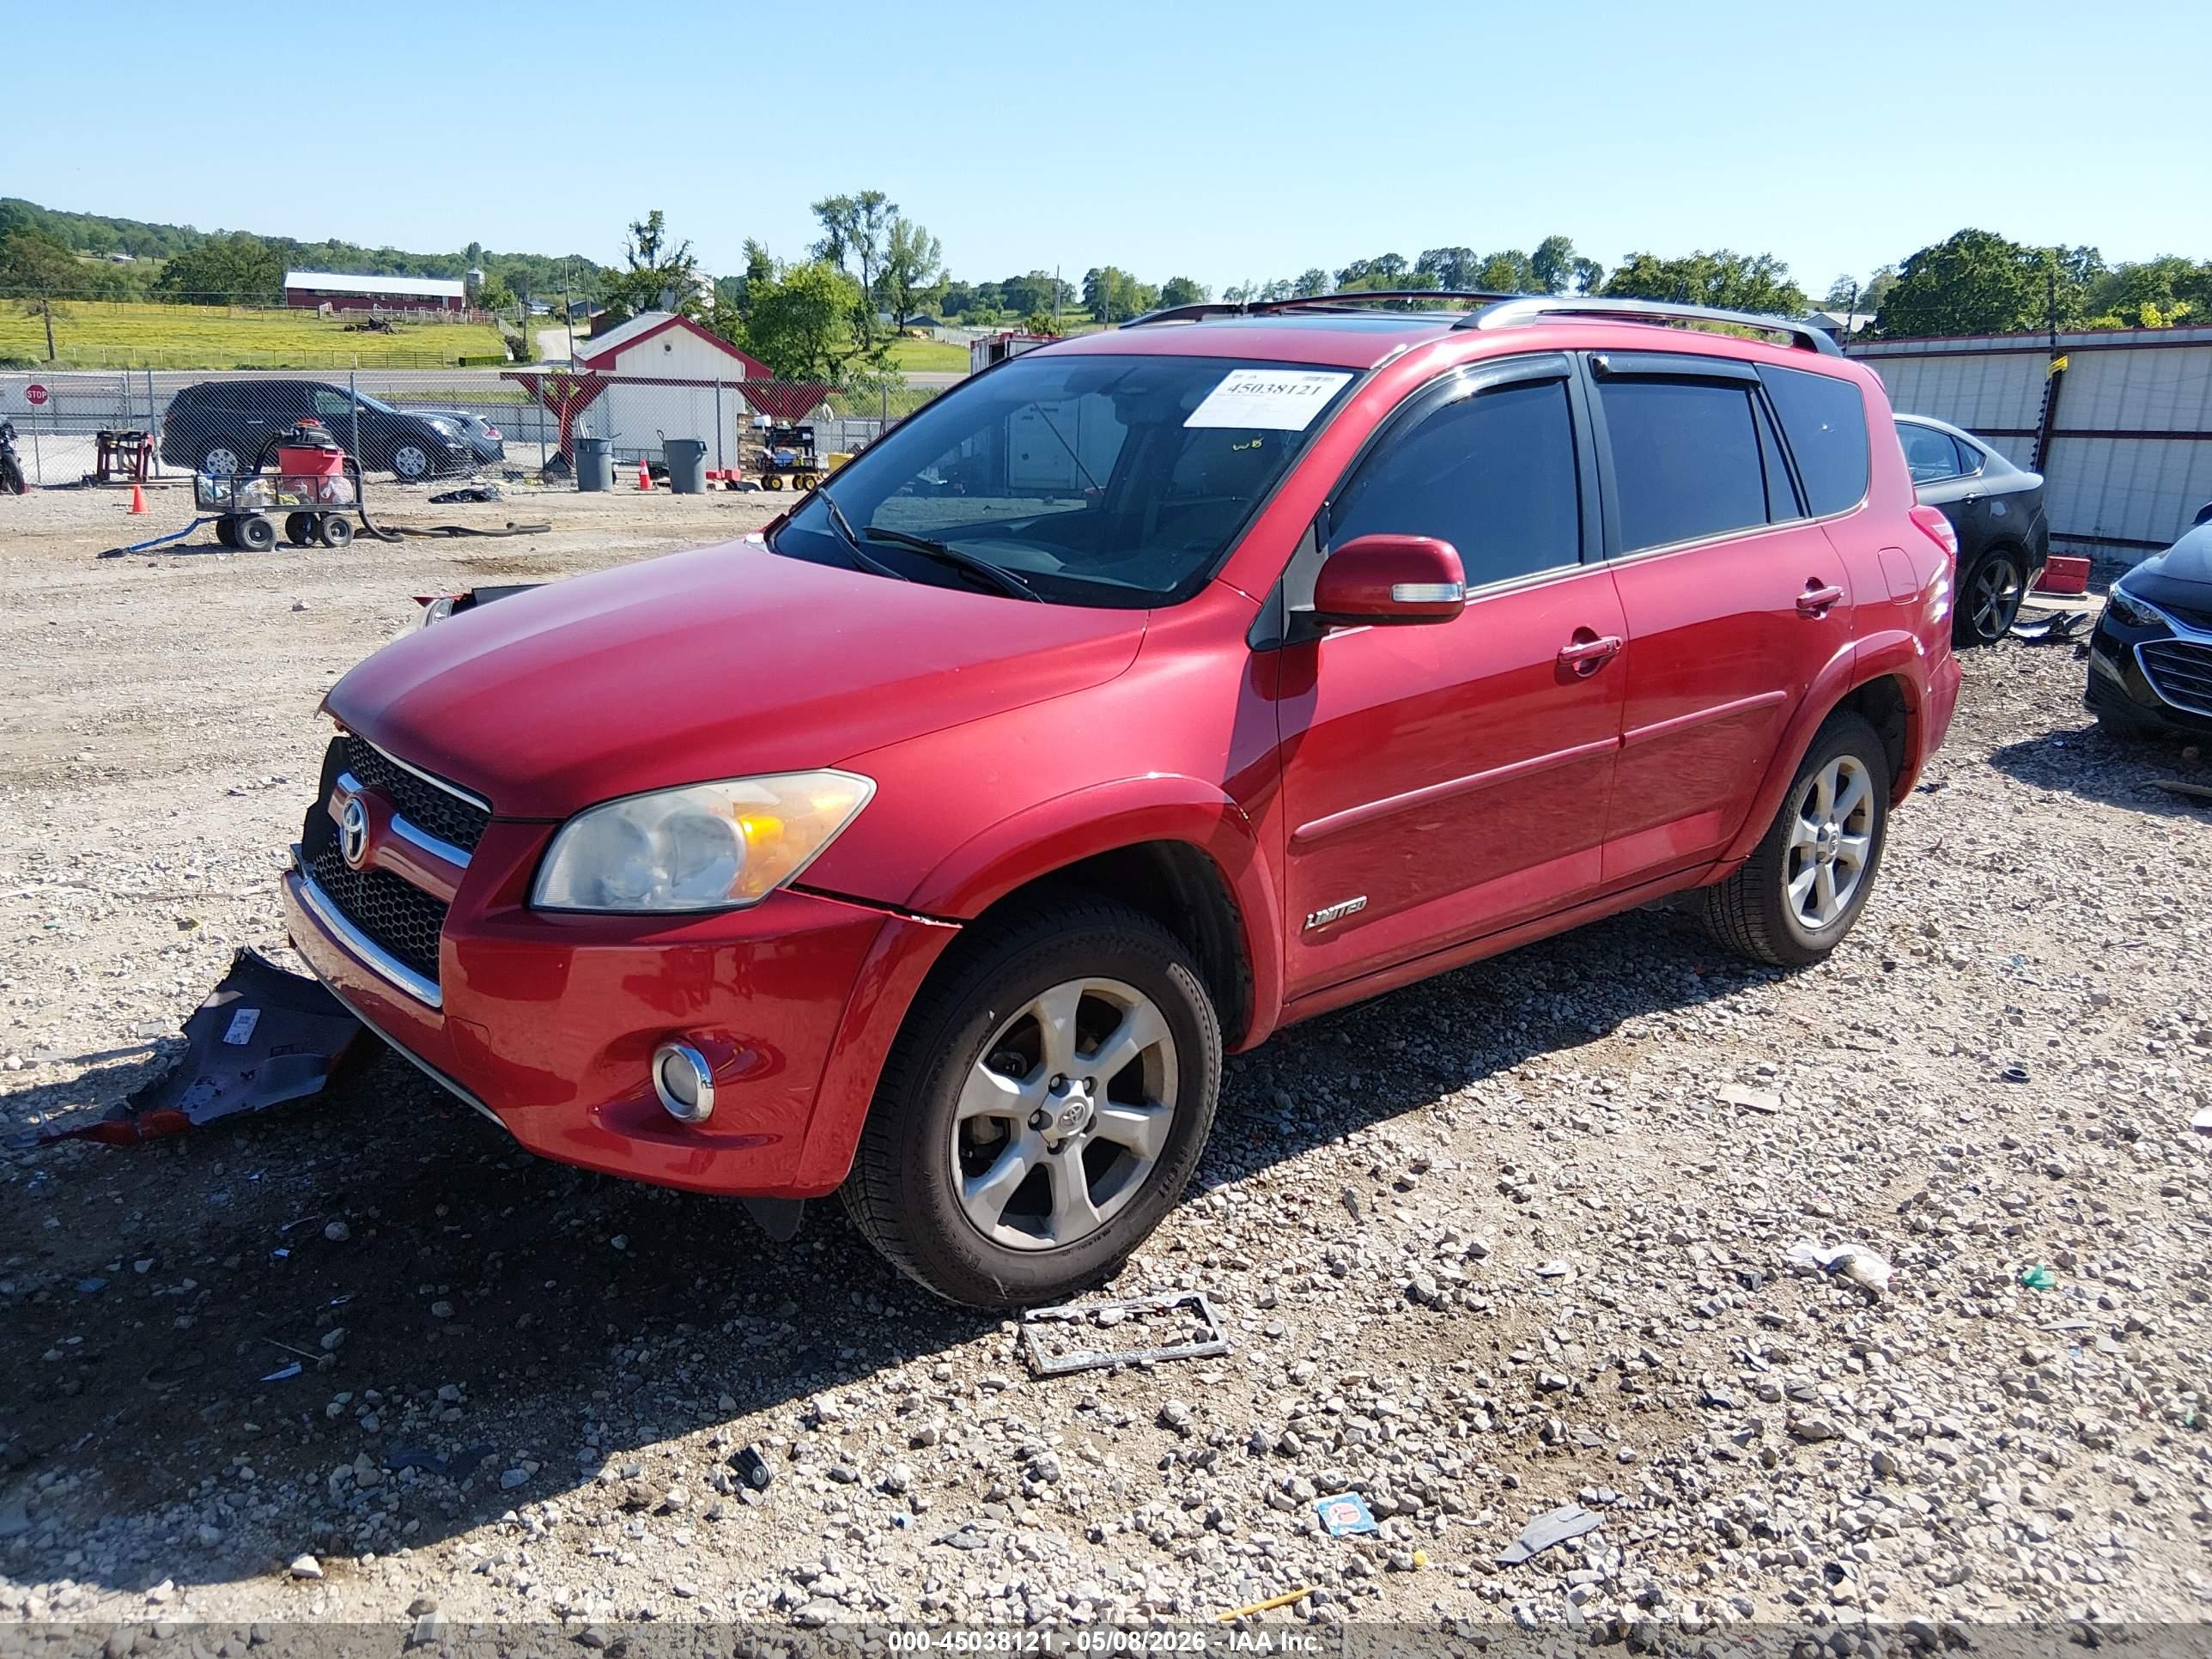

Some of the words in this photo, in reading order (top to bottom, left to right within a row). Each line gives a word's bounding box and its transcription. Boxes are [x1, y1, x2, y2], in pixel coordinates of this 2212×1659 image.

[27, 390, 47, 399] STOP
[1228, 383, 1322, 395] 45038121
[1304, 895, 1368, 930] LIMITED
